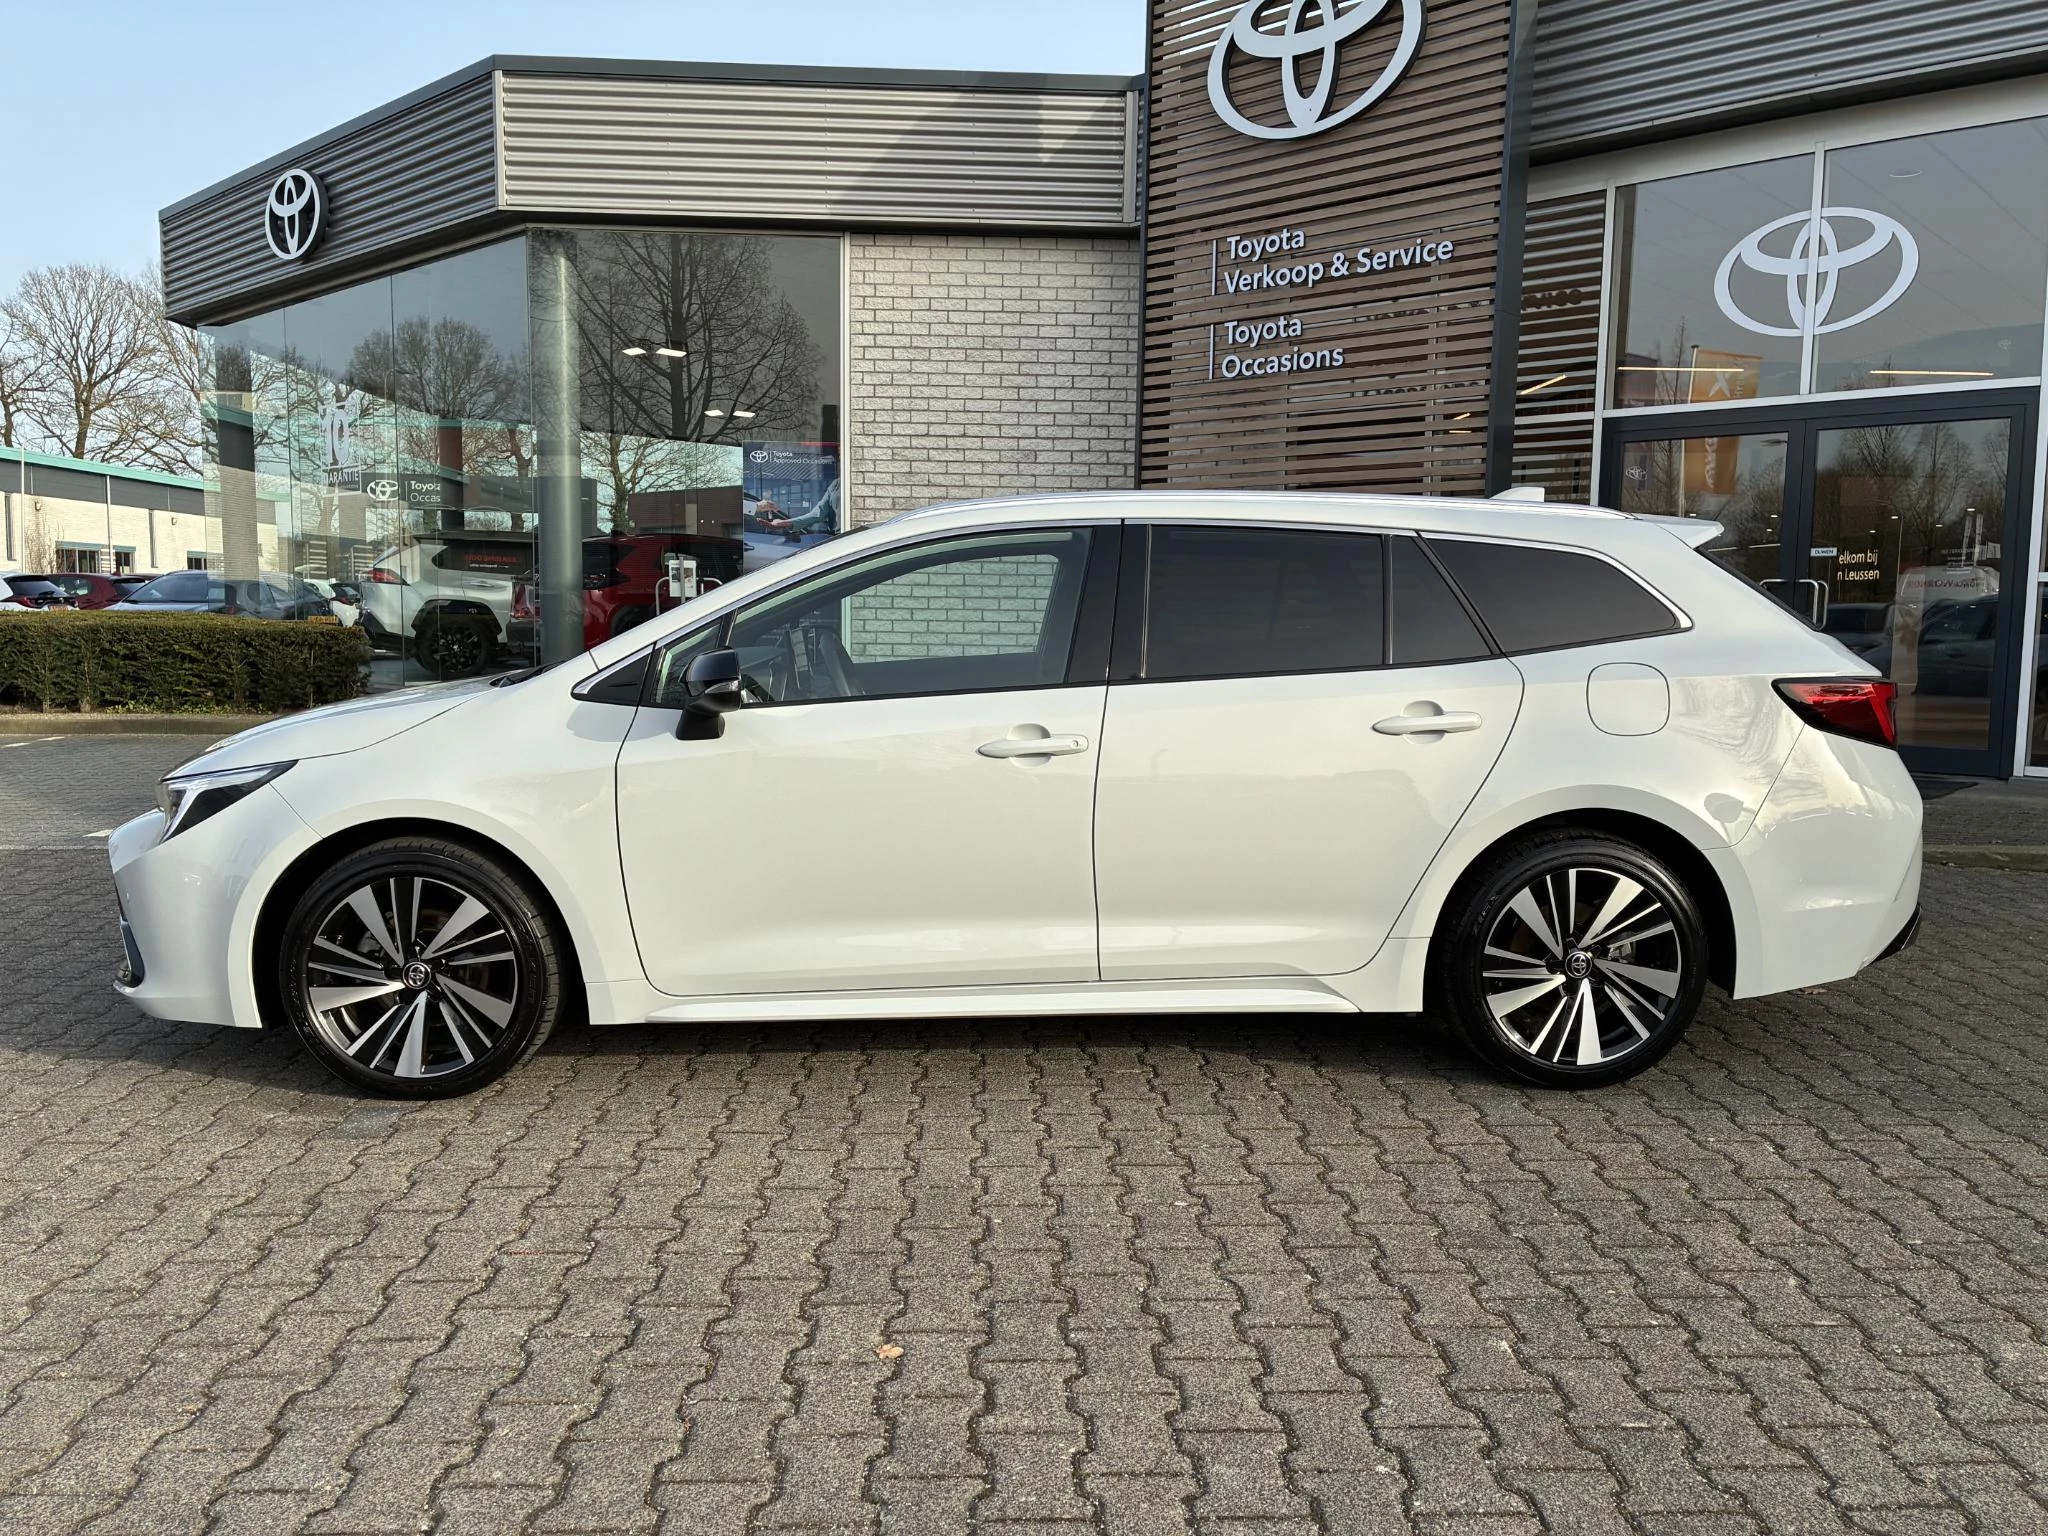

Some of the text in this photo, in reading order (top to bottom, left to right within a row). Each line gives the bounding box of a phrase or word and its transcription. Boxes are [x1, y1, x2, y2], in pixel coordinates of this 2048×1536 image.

[1226, 228, 1305, 262] Toyota
[1224, 238, 1454, 294] Verkoop & Service
[1224, 316, 1303, 347] Toyota
[1221, 346, 1344, 378] Occasions
[773, 450, 793, 458] Toyota
[410, 492, 440, 503] Occas
[1838, 548, 1879, 566] elkom bij
[1845, 568, 1880, 581] Leussen
